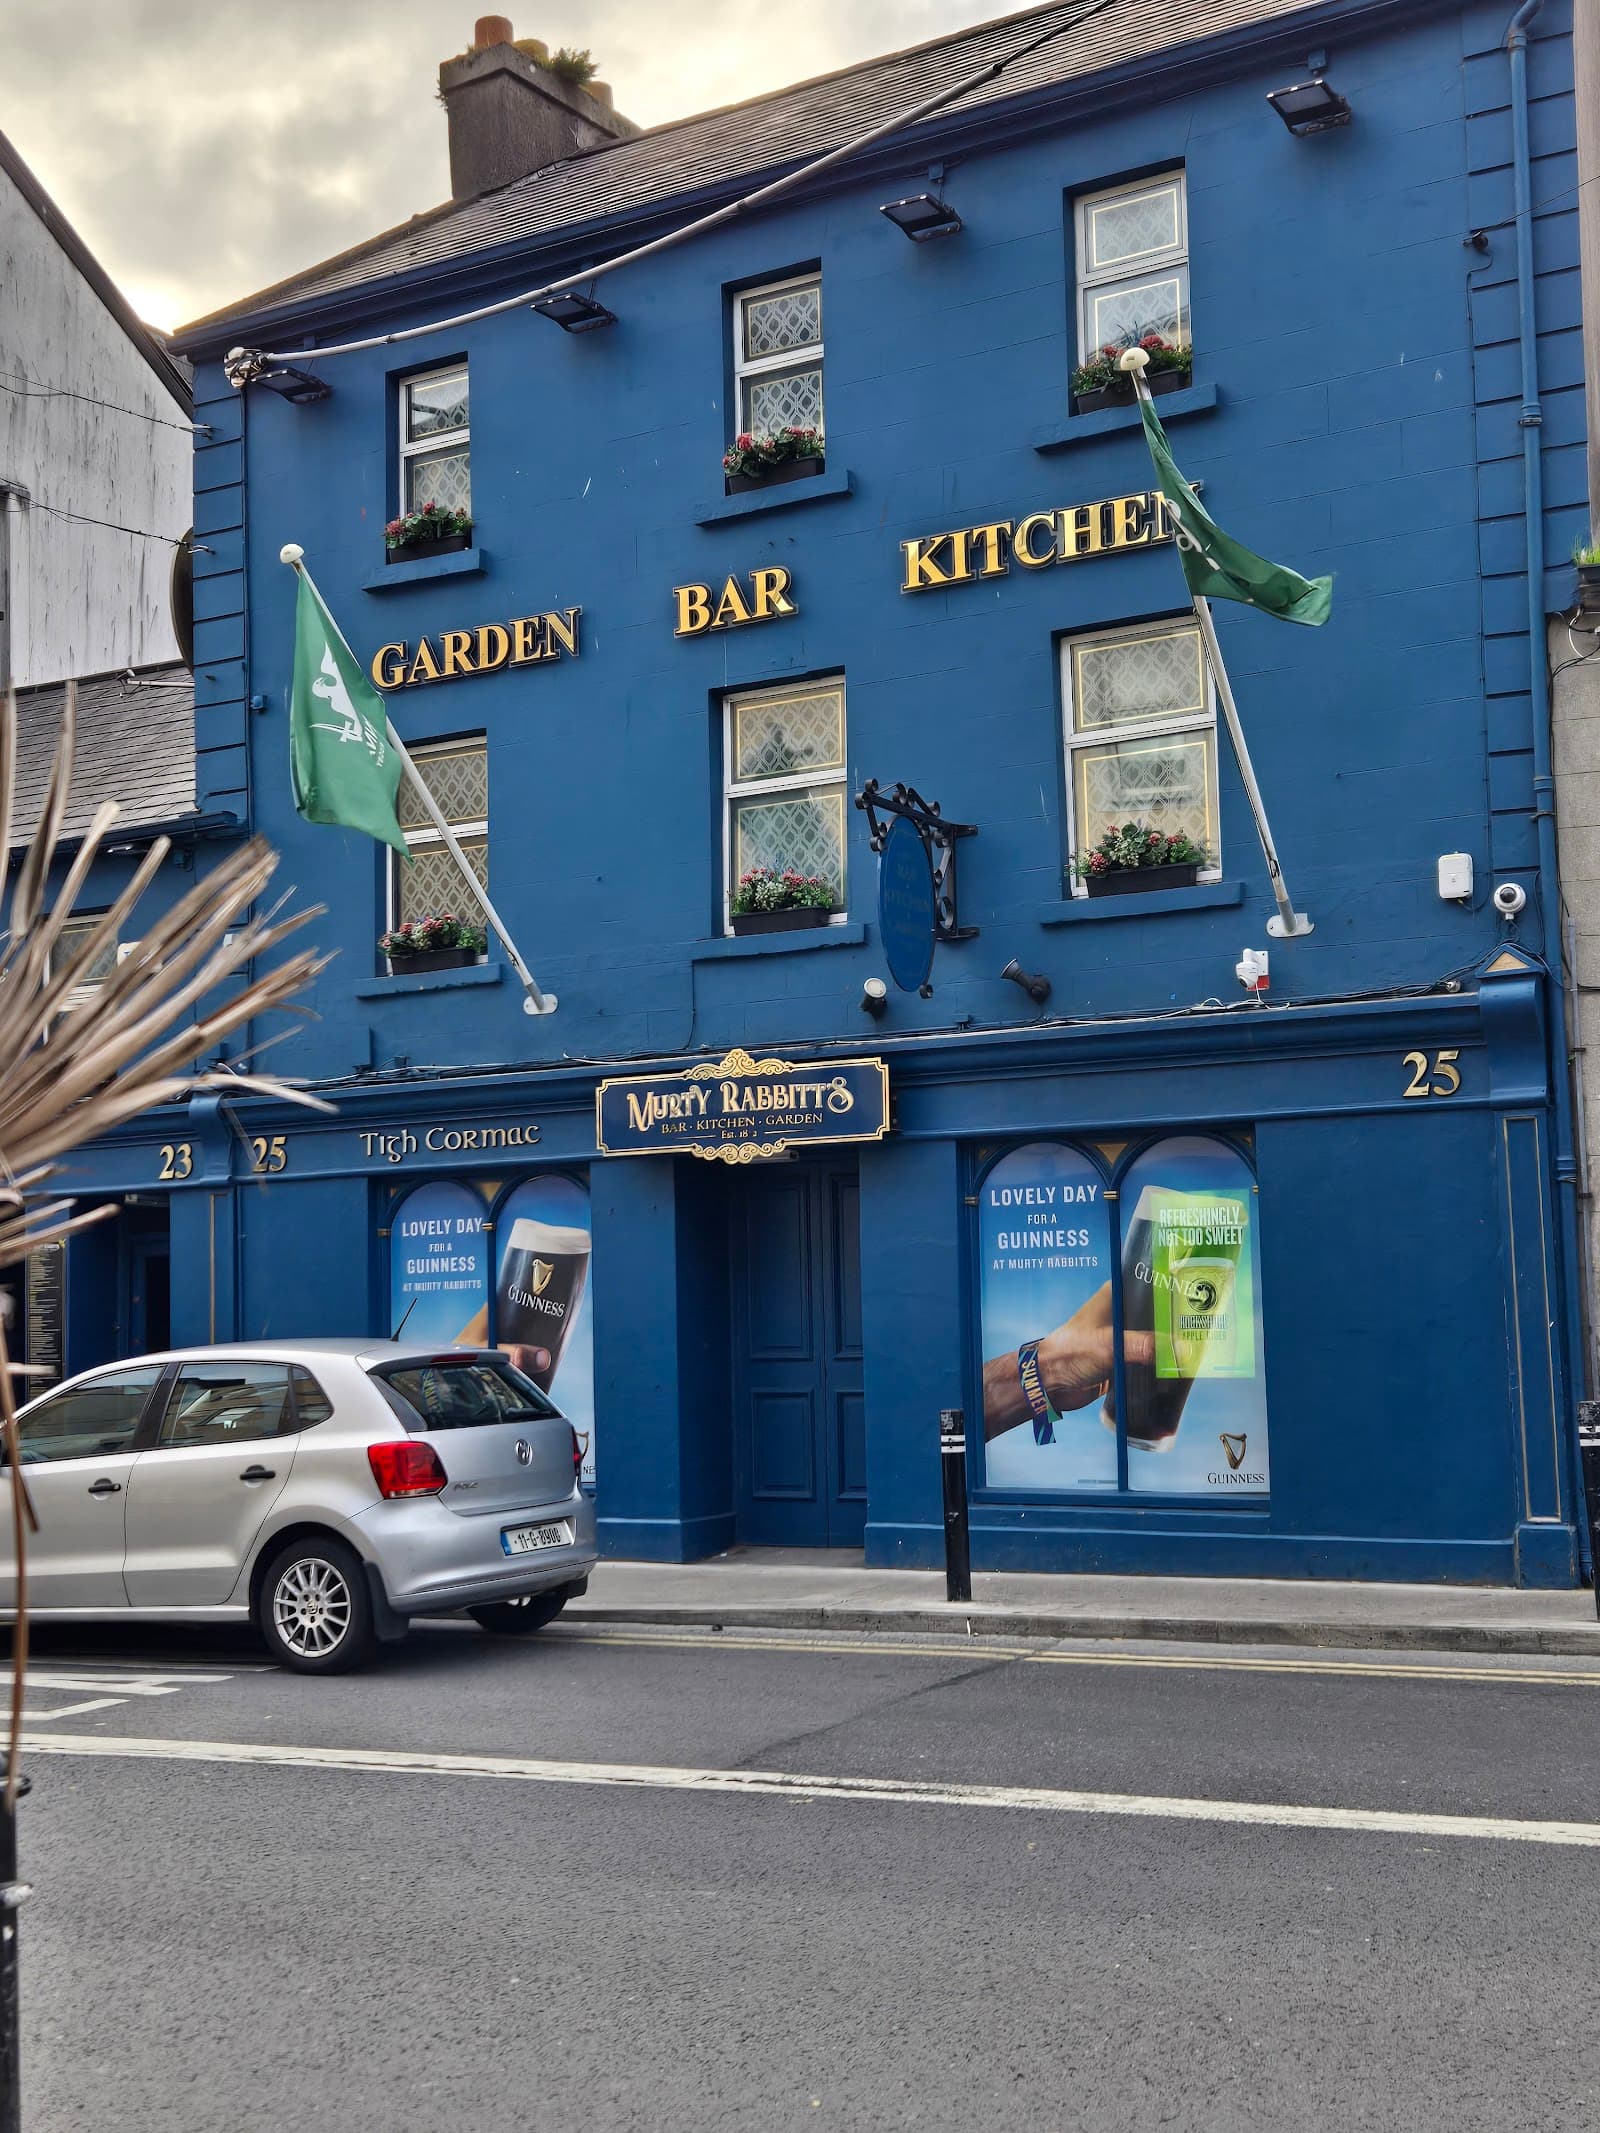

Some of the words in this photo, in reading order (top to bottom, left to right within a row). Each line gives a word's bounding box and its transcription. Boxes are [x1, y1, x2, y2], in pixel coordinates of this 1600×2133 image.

[673, 566, 798, 637] BAR
[371, 605, 583, 691] GARDEN
[1402, 1049, 1461, 1099] 25
[661, 1120, 687, 1134] BAR
[696, 1115, 756, 1131] KITCHEN
[765, 1112, 824, 1126] GARDEN
[158, 1143, 193, 1181] 23
[252, 1136, 288, 1173] 25
[991, 1186, 1058, 1207] LOVELY
[1062, 1184, 1098, 1203] DAY
[402, 1218, 451, 1237] LOVELY
[456, 1217, 483, 1234] DAY
[1027, 1213, 1048, 1225] FOR
[1050, 1212, 1058, 1225] A
[1159, 1206, 1240, 1226] REFRESHINGLY
[429, 1243, 445, 1252] FOR
[446, 1242, 453, 1252] A
[997, 1228, 1090, 1250] GUINNESS
[1158, 1227, 1179, 1247] NOT
[1183, 1227, 1204, 1247] TOO
[1205, 1225, 1243, 1246] SWEET
[407, 1256, 476, 1274] GUINNESS
[993, 1258, 1006, 1270] AT
[1008, 1257, 1044, 1270] MURTY
[1047, 1255, 1099, 1269] RABBITTS
[508, 1283, 565, 1318] GUINNESS
[1021, 1360, 1049, 1414] SUMMER
[1207, 1471, 1265, 1485] GUINNESS
